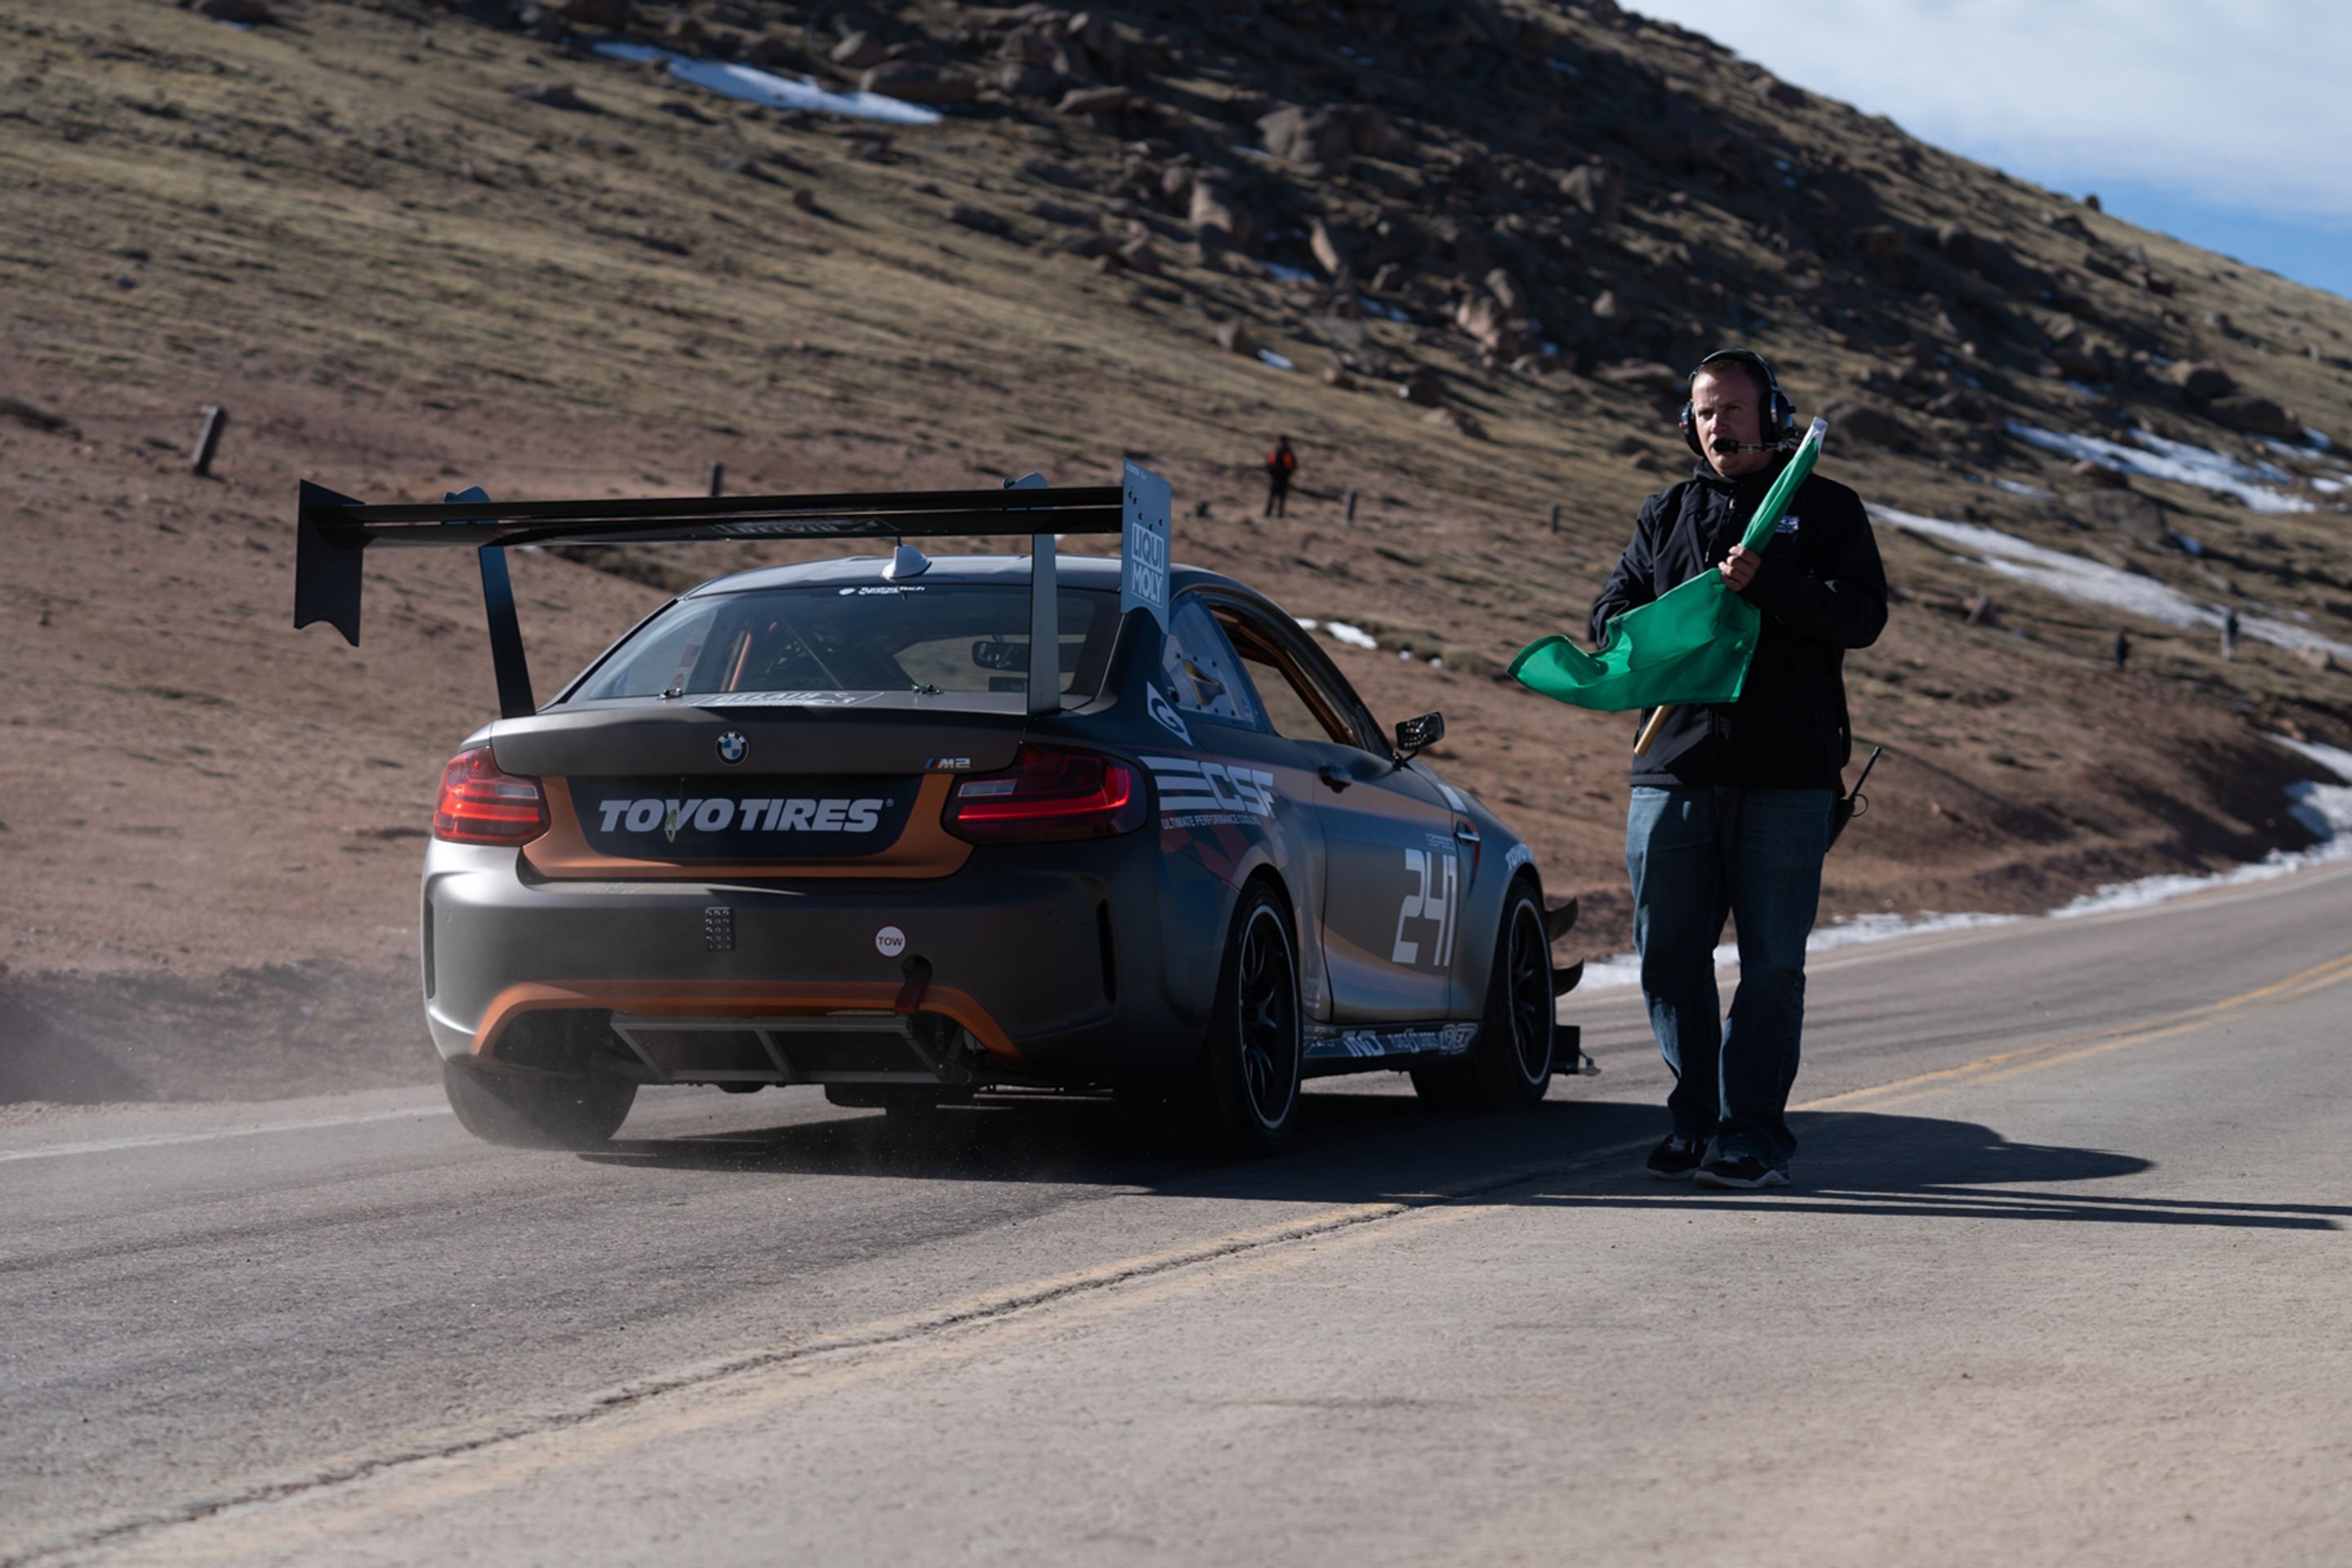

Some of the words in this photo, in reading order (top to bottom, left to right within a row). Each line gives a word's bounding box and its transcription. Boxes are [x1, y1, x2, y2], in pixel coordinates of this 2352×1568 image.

[1134, 526, 1162, 569] LIQUI
[1133, 561, 1163, 604] MOLY
[719, 732, 746, 743] BMW
[938, 757, 971, 769] M2
[1199, 761, 1276, 819] CSF
[598, 798, 735, 832] TOYO
[738, 799, 884, 832] TIRES
[1161, 815, 1196, 830] ULTIMATE
[878, 936, 902, 947] TOW
